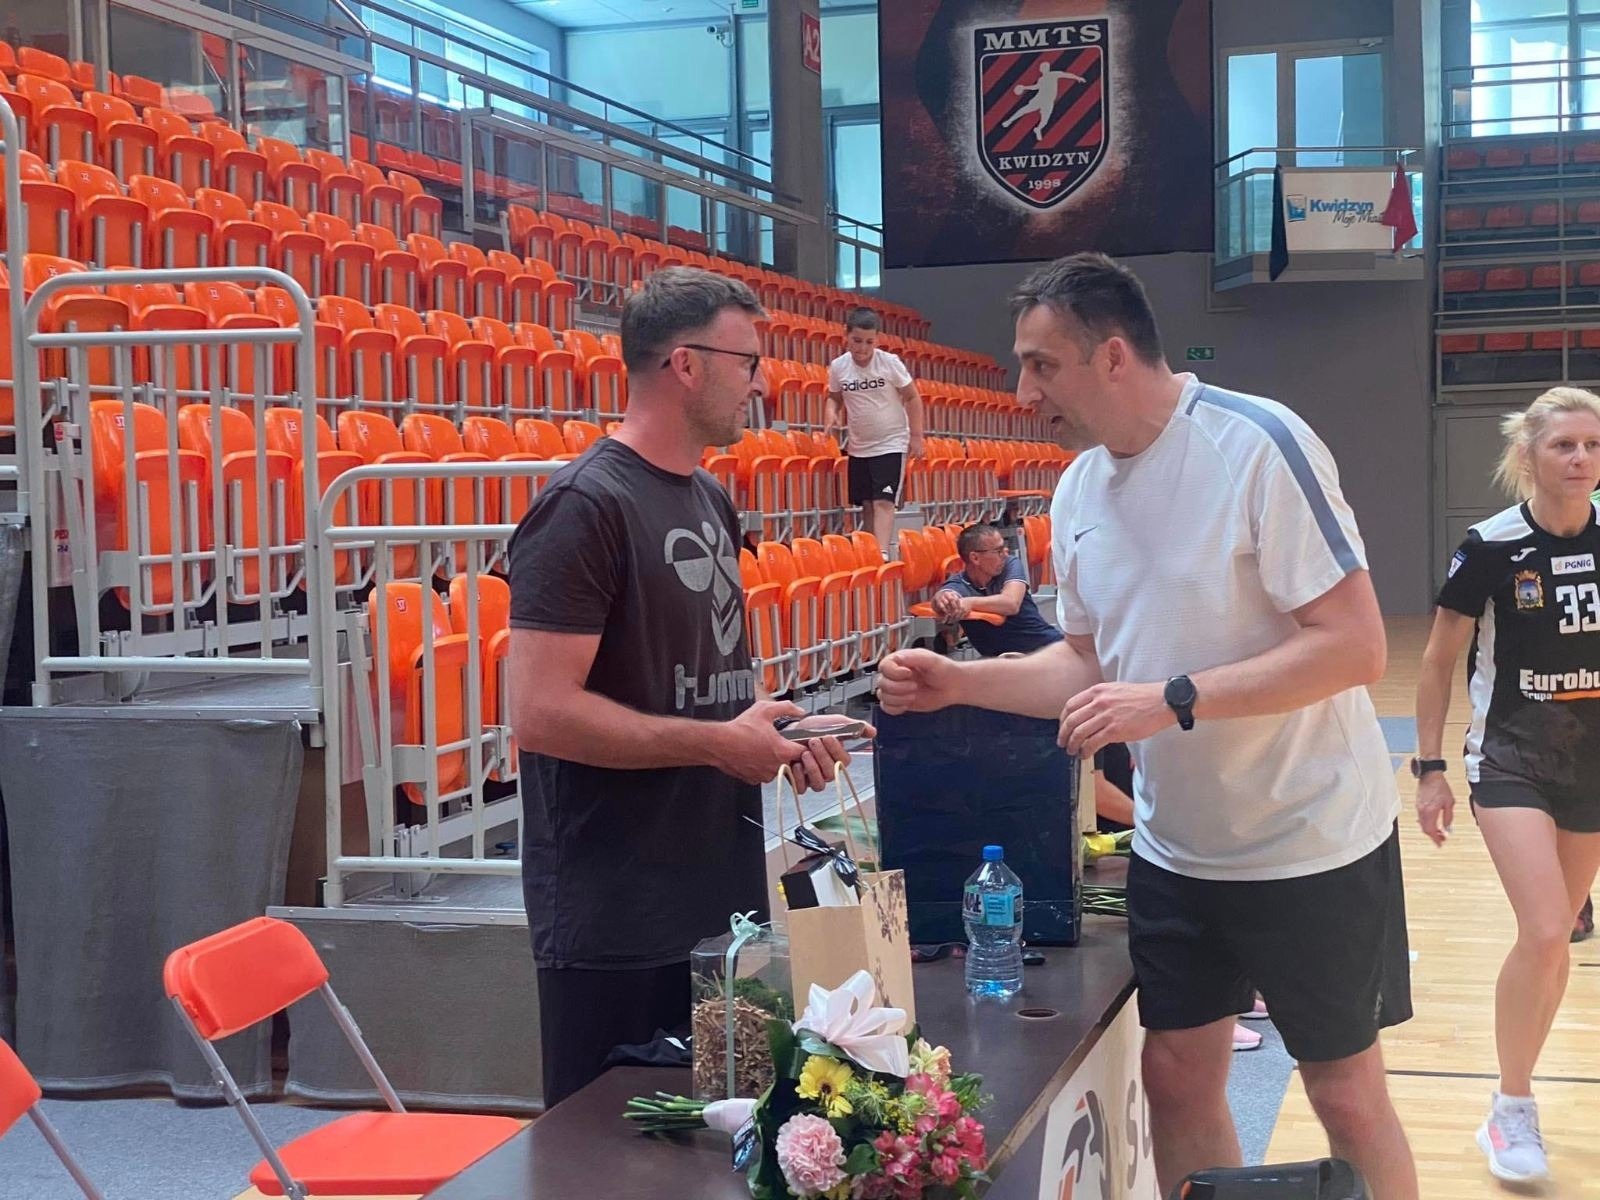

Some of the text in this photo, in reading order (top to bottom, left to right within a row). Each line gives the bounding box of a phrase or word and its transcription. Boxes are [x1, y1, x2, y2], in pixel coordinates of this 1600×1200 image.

[803, 24, 820, 63] A2
[983, 24, 1101, 51] MMTS
[999, 151, 1090, 170] KWIDZYN
[1028, 178, 1061, 190] 1998
[1310, 199, 1374, 215] Kwidzyn
[841, 377, 885, 391] adidas
[1555, 582, 1600, 634] 33
